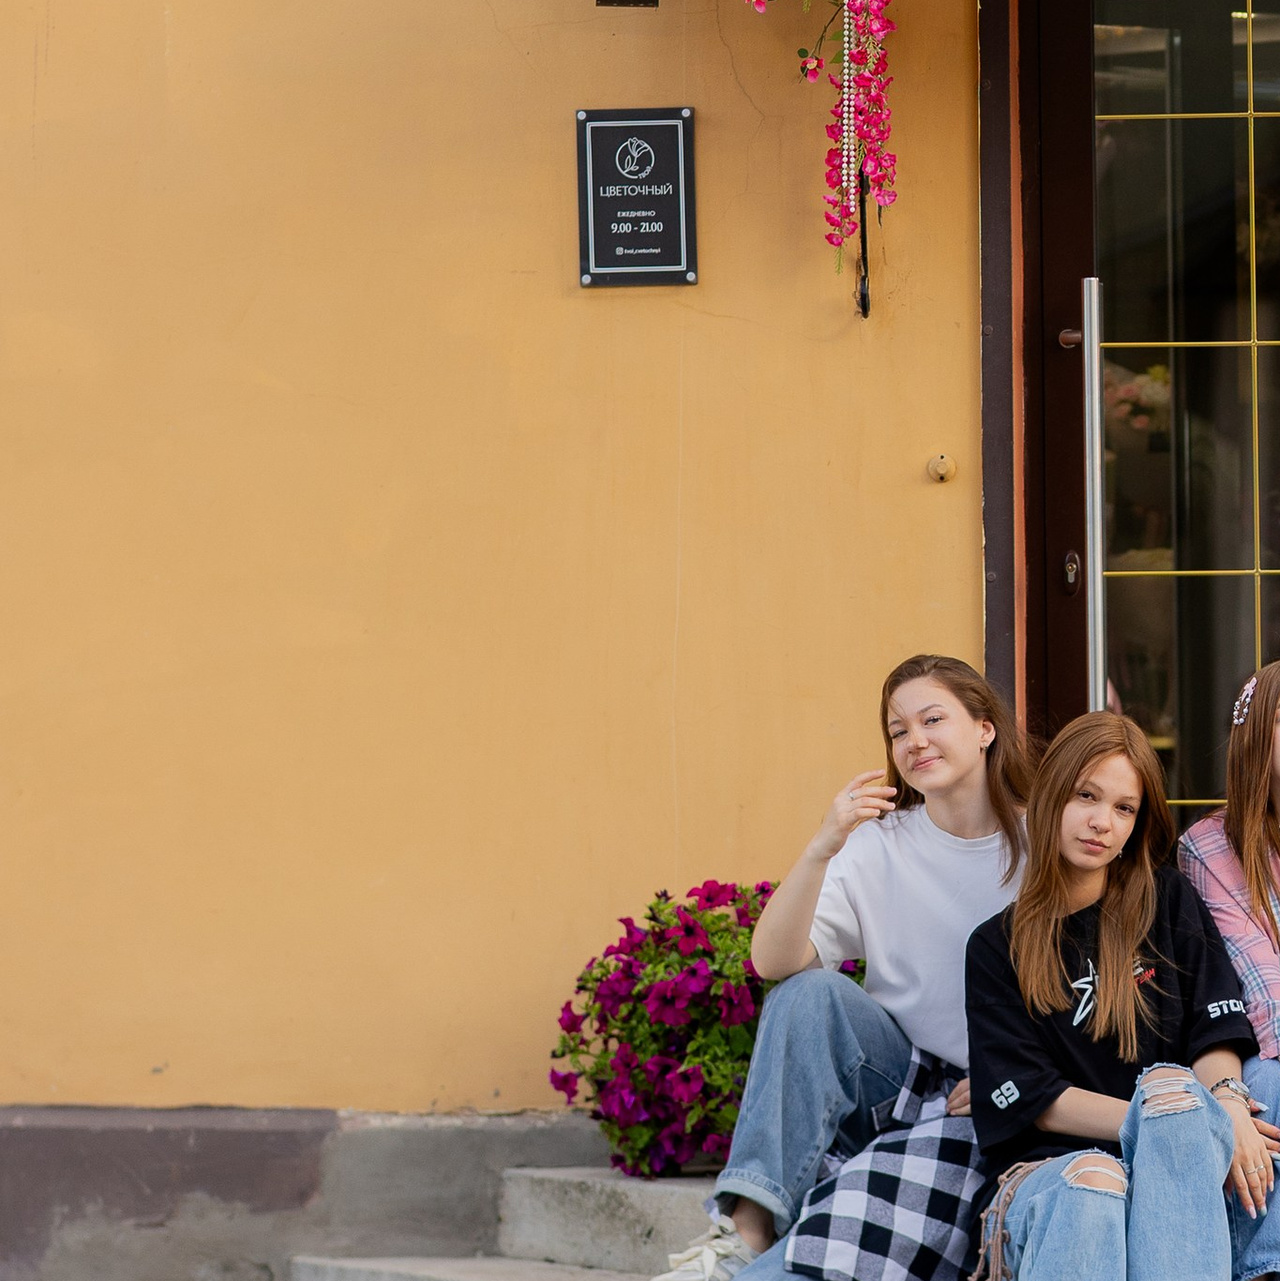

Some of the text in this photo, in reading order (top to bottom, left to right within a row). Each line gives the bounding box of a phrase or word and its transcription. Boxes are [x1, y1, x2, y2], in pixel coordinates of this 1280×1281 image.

[600, 183, 672, 197] ЦВЕТОЧНЫЙ
[611, 223, 632, 233] 9.00
[640, 222, 663, 233] 21.00
[991, 1080, 1020, 1110] 69
